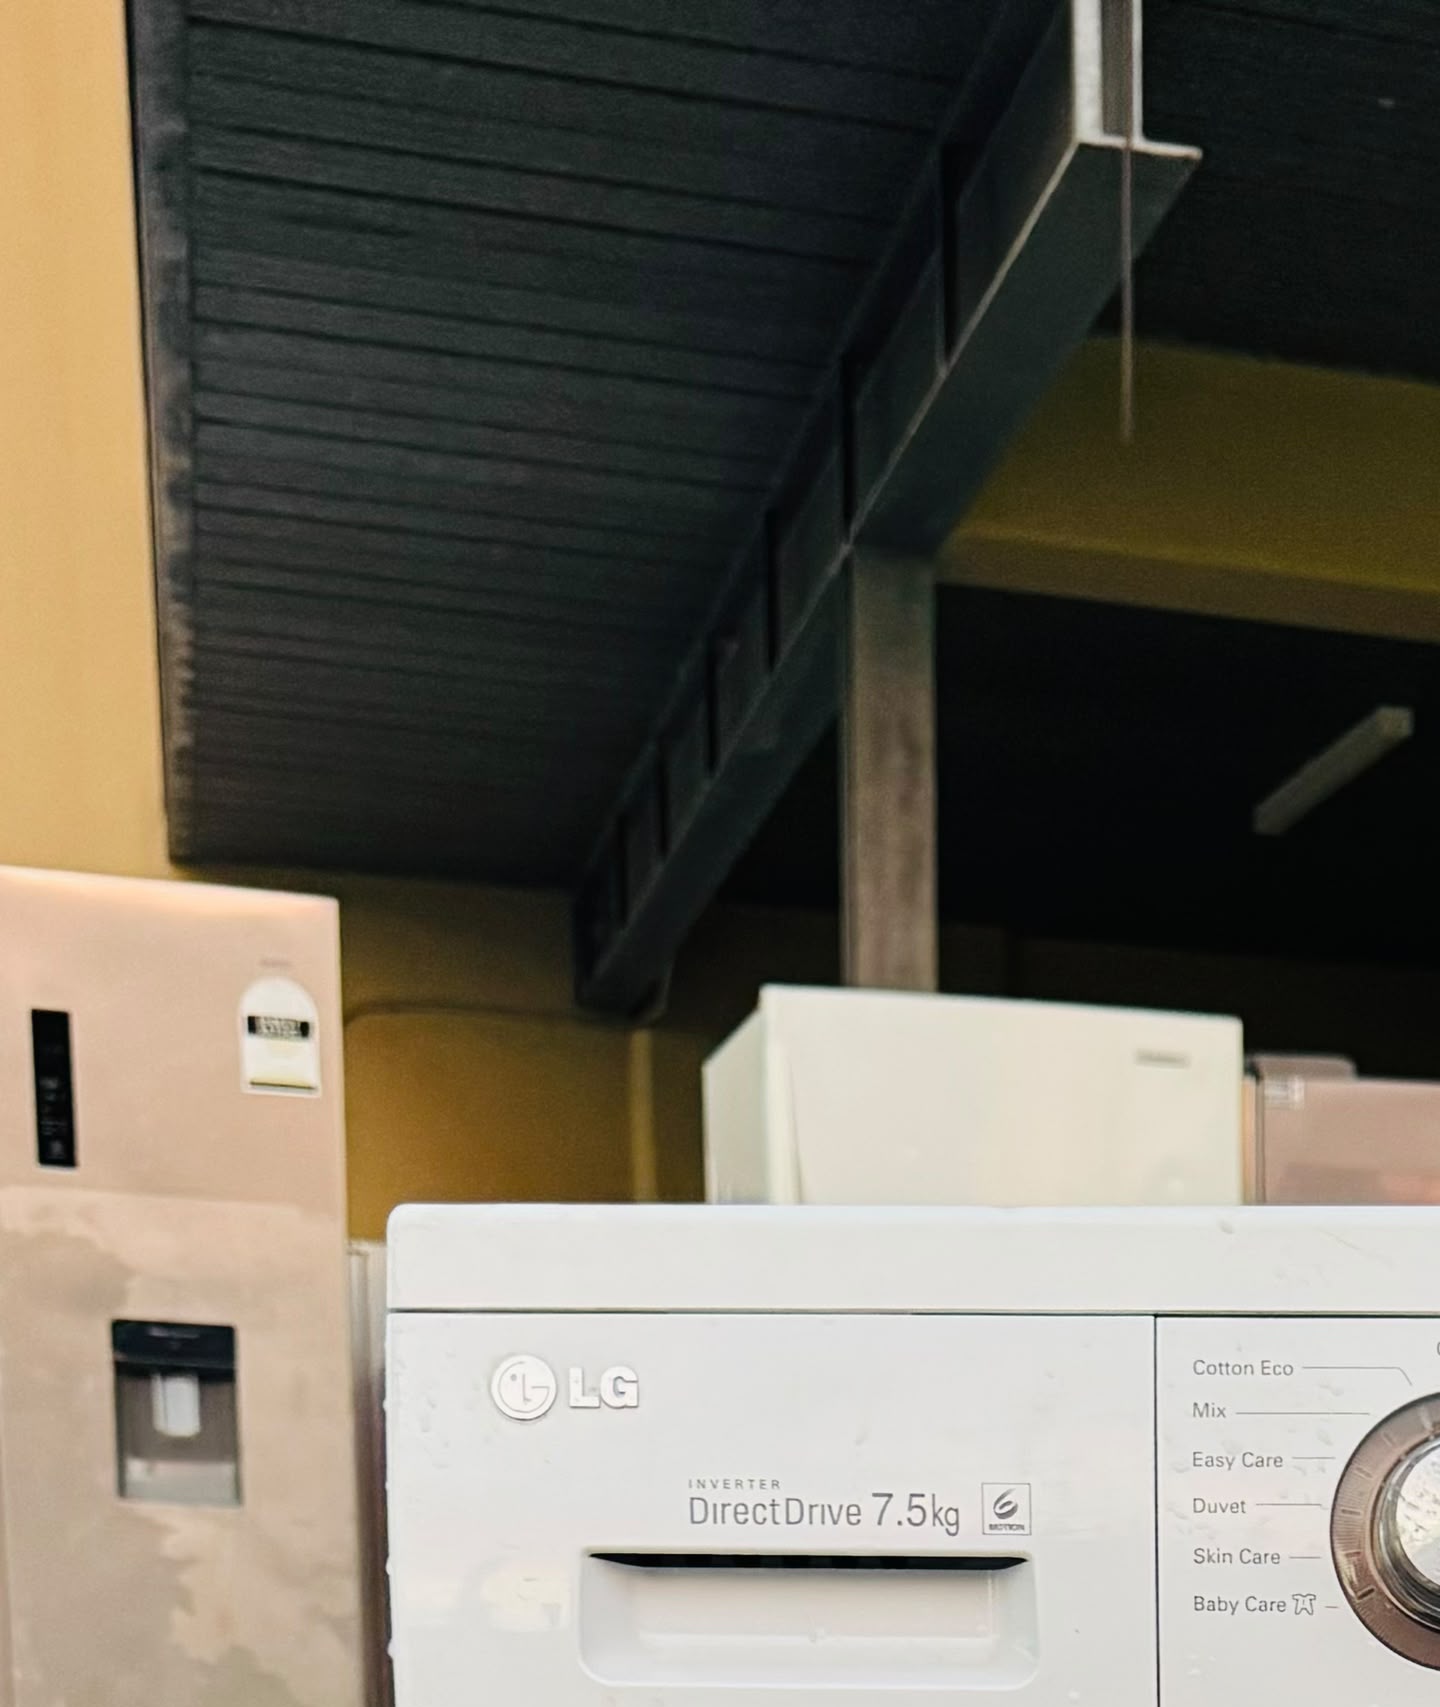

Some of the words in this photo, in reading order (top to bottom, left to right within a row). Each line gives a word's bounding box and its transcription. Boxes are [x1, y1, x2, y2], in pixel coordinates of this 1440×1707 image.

[1192, 1359, 1255, 1376] Cotton
[1260, 1360, 1294, 1376] Eco
[568, 1366, 640, 1410] LG
[1192, 1403, 1227, 1418] Mix
[1192, 1452, 1236, 1471] Easy
[1241, 1452, 1284, 1468] Care
[688, 1478, 781, 1490] INVERTER
[872, 1493, 960, 1537] 7.5kg
[1192, 1498, 1247, 1515] Duvet
[1193, 1548, 1234, 1565] Skin
[1239, 1549, 1281, 1565] Care
[1193, 1596, 1238, 1615] Baby
[1244, 1596, 1287, 1612] Care
